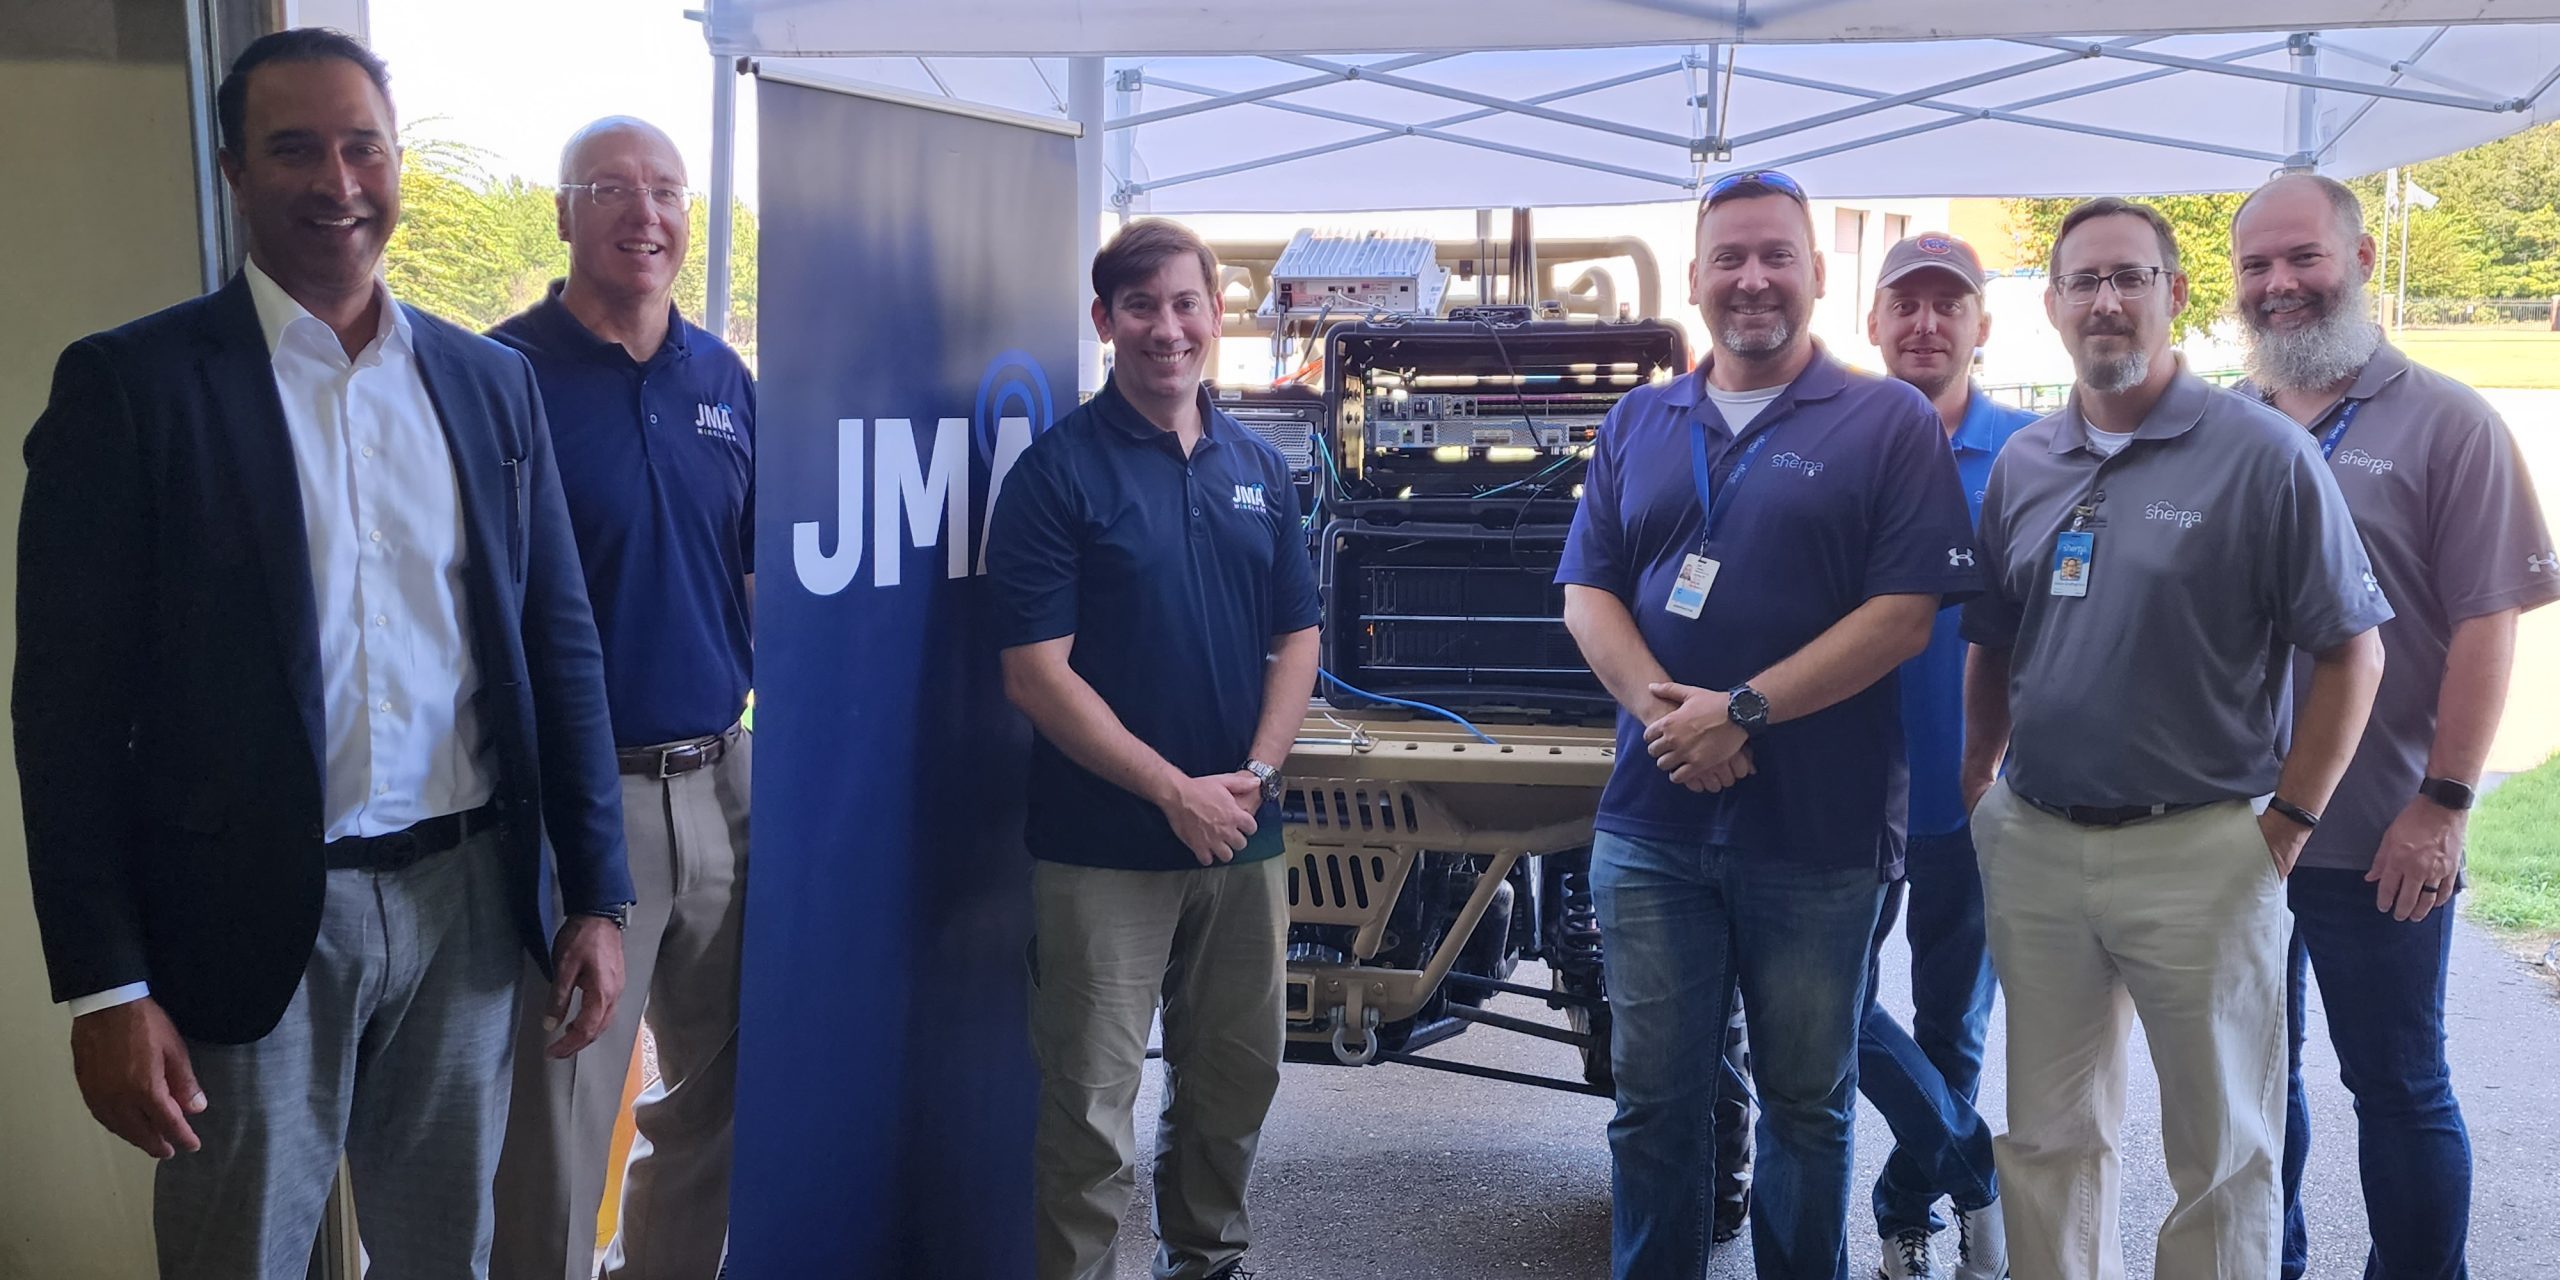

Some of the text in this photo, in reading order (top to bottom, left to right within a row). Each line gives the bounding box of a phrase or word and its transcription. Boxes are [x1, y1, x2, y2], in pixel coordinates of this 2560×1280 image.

[695, 403, 735, 433] JMA
[1771, 455, 1824, 475] sherpa
[2339, 451, 2394, 473] sherpa
[1232, 484, 1266, 507] JMA
[2145, 506, 2202, 528] sherpa
